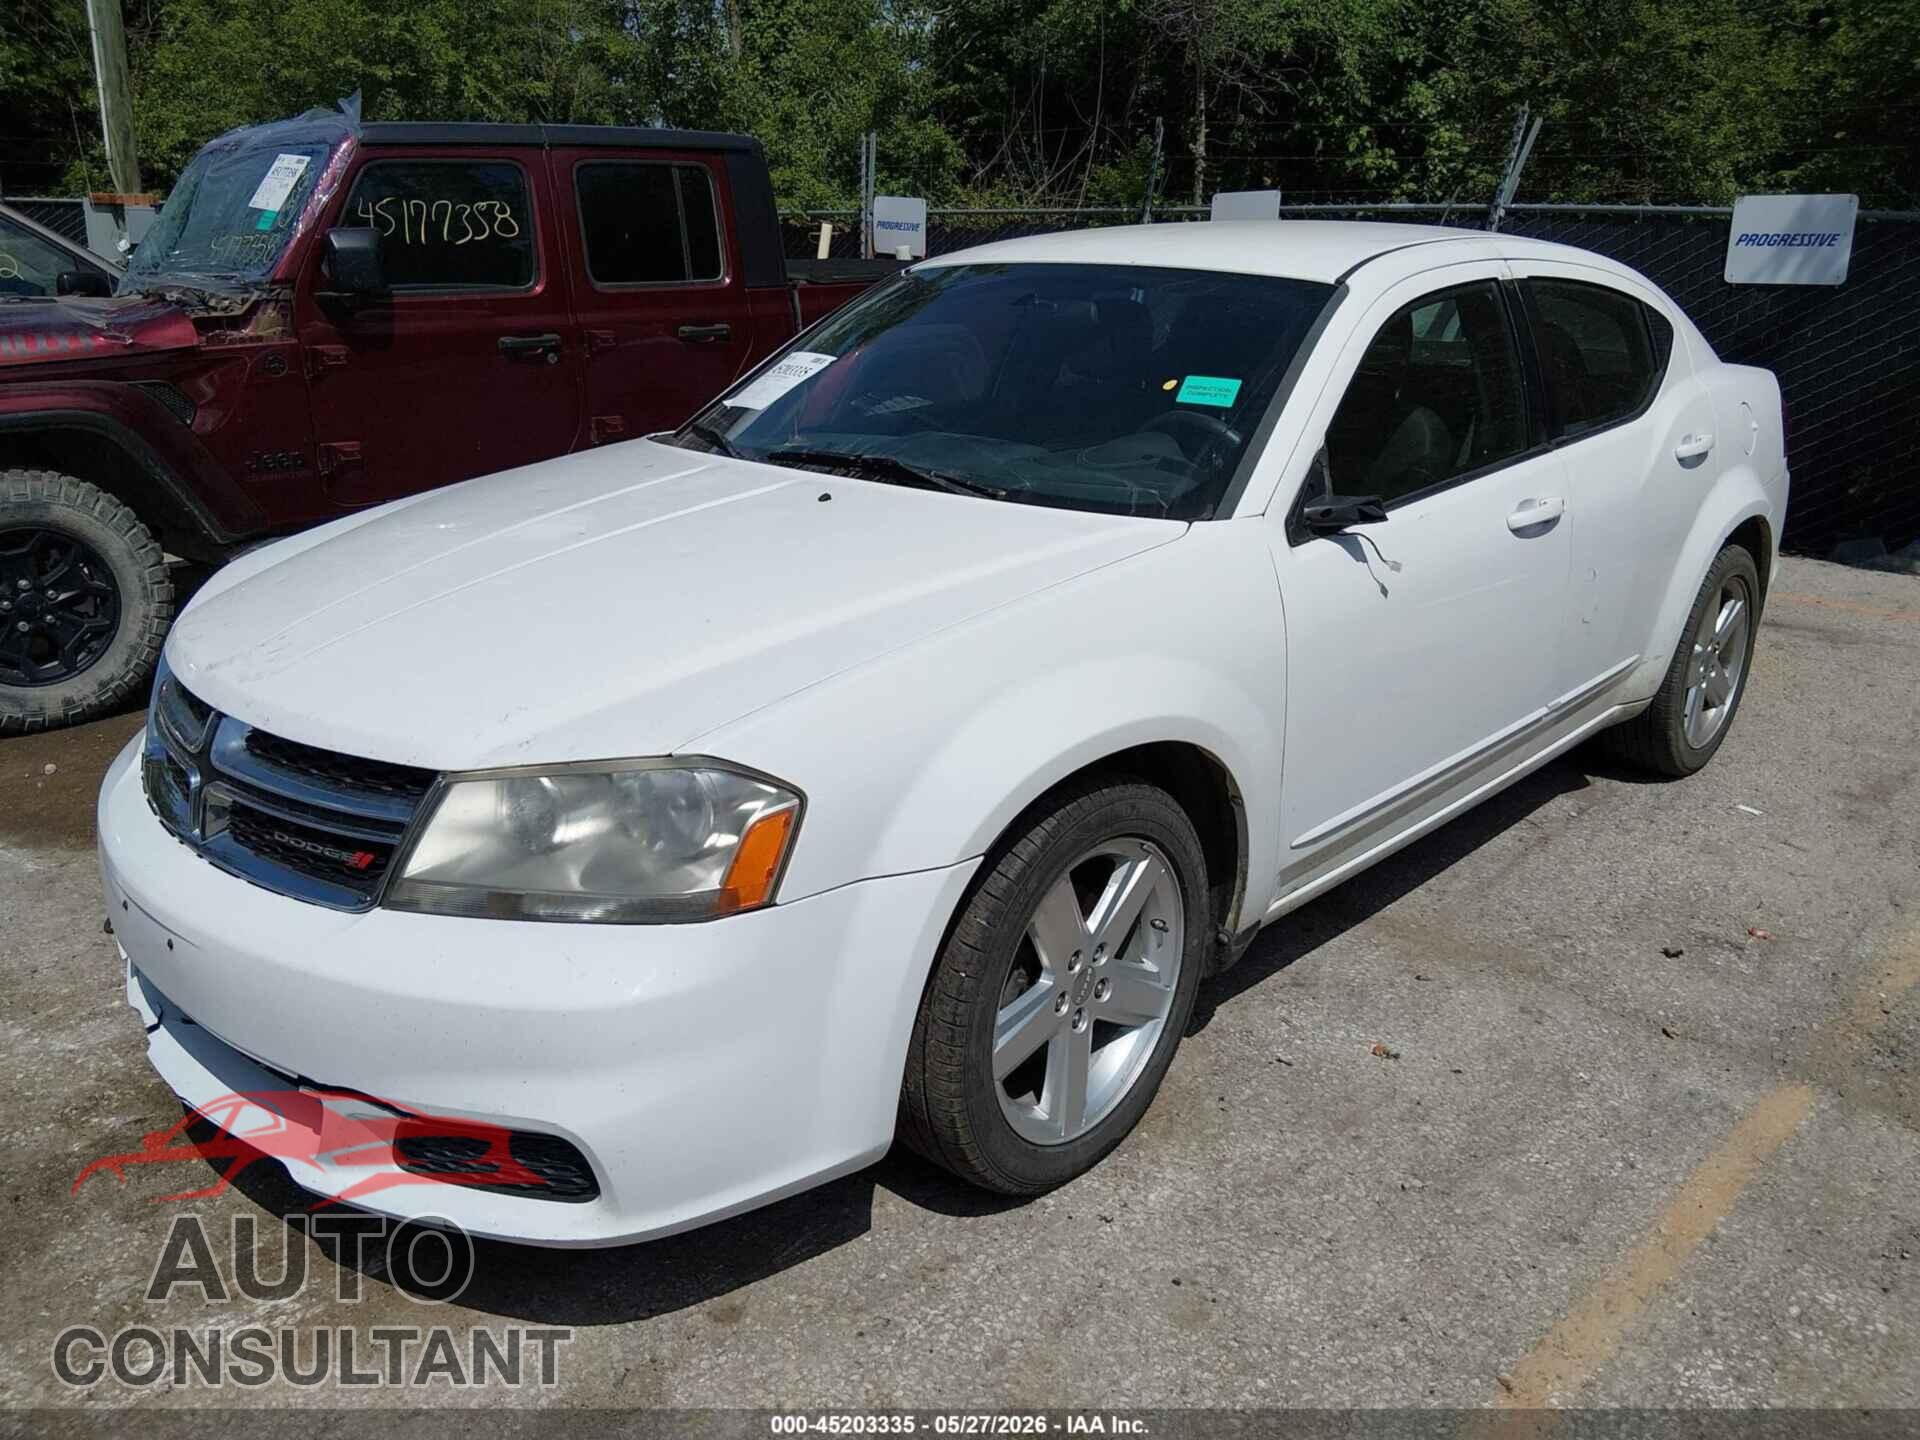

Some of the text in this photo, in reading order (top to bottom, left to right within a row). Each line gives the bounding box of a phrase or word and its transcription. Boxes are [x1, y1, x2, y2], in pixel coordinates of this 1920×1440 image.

[358, 196, 519, 245] 45177358
[1735, 233, 1841, 247] PROGRESSIVE
[273, 831, 361, 864] DODGE
